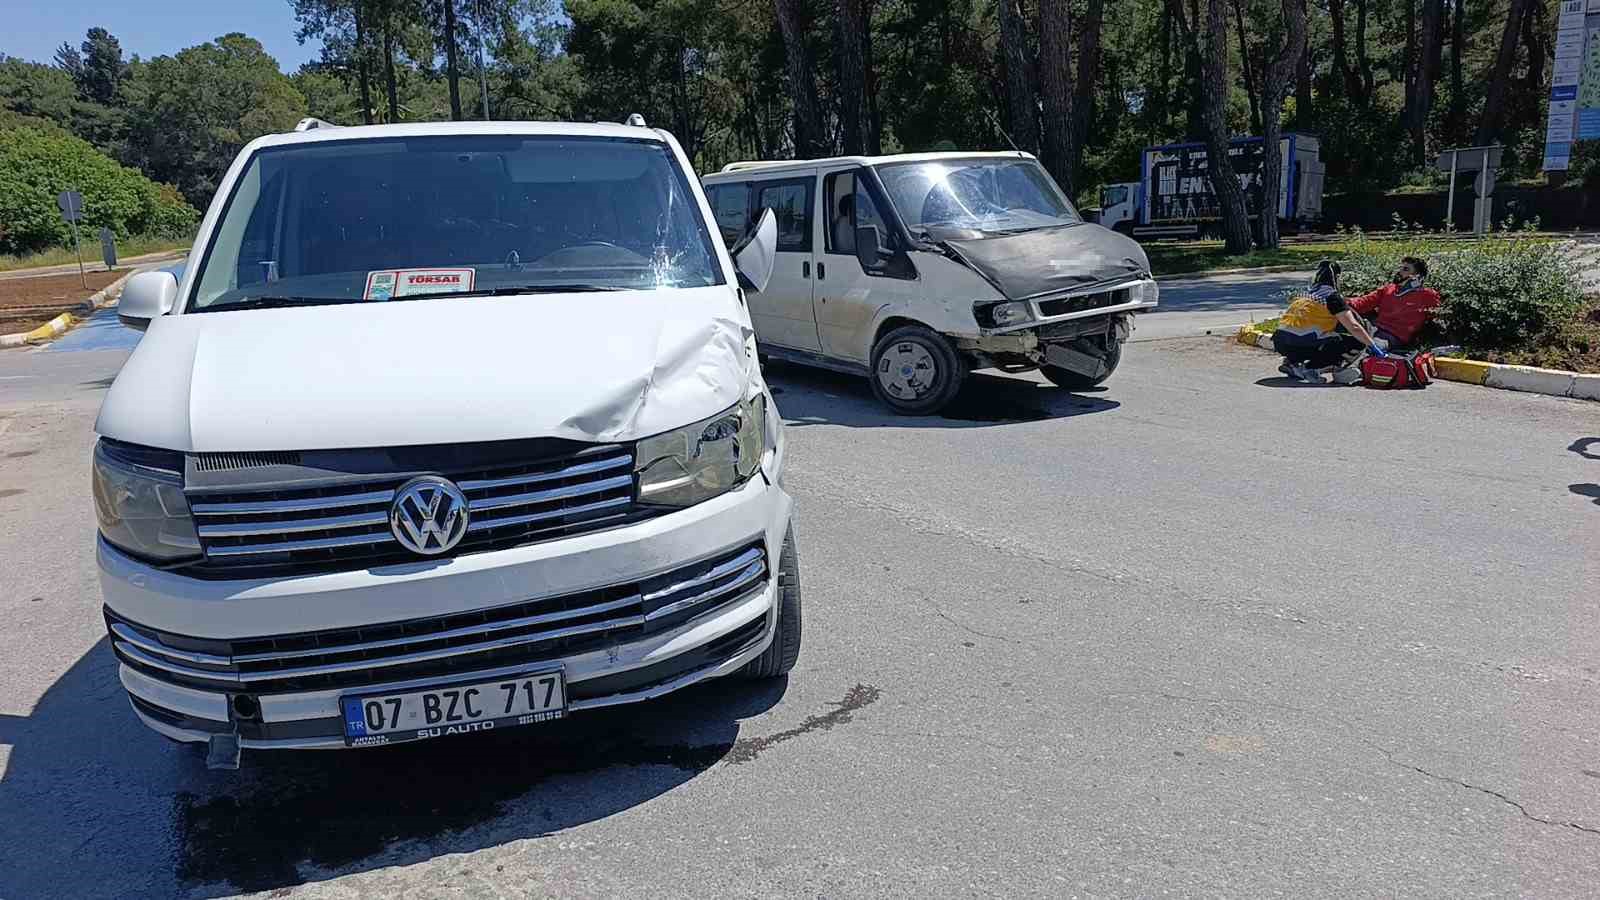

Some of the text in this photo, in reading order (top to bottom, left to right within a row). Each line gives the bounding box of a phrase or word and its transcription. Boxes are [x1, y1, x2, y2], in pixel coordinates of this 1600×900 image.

[348, 720, 365, 731] TR
[364, 697, 403, 732] 07
[422, 688, 483, 725] BZC
[500, 676, 556, 714] 717
[416, 720, 495, 738] SU AUTO
